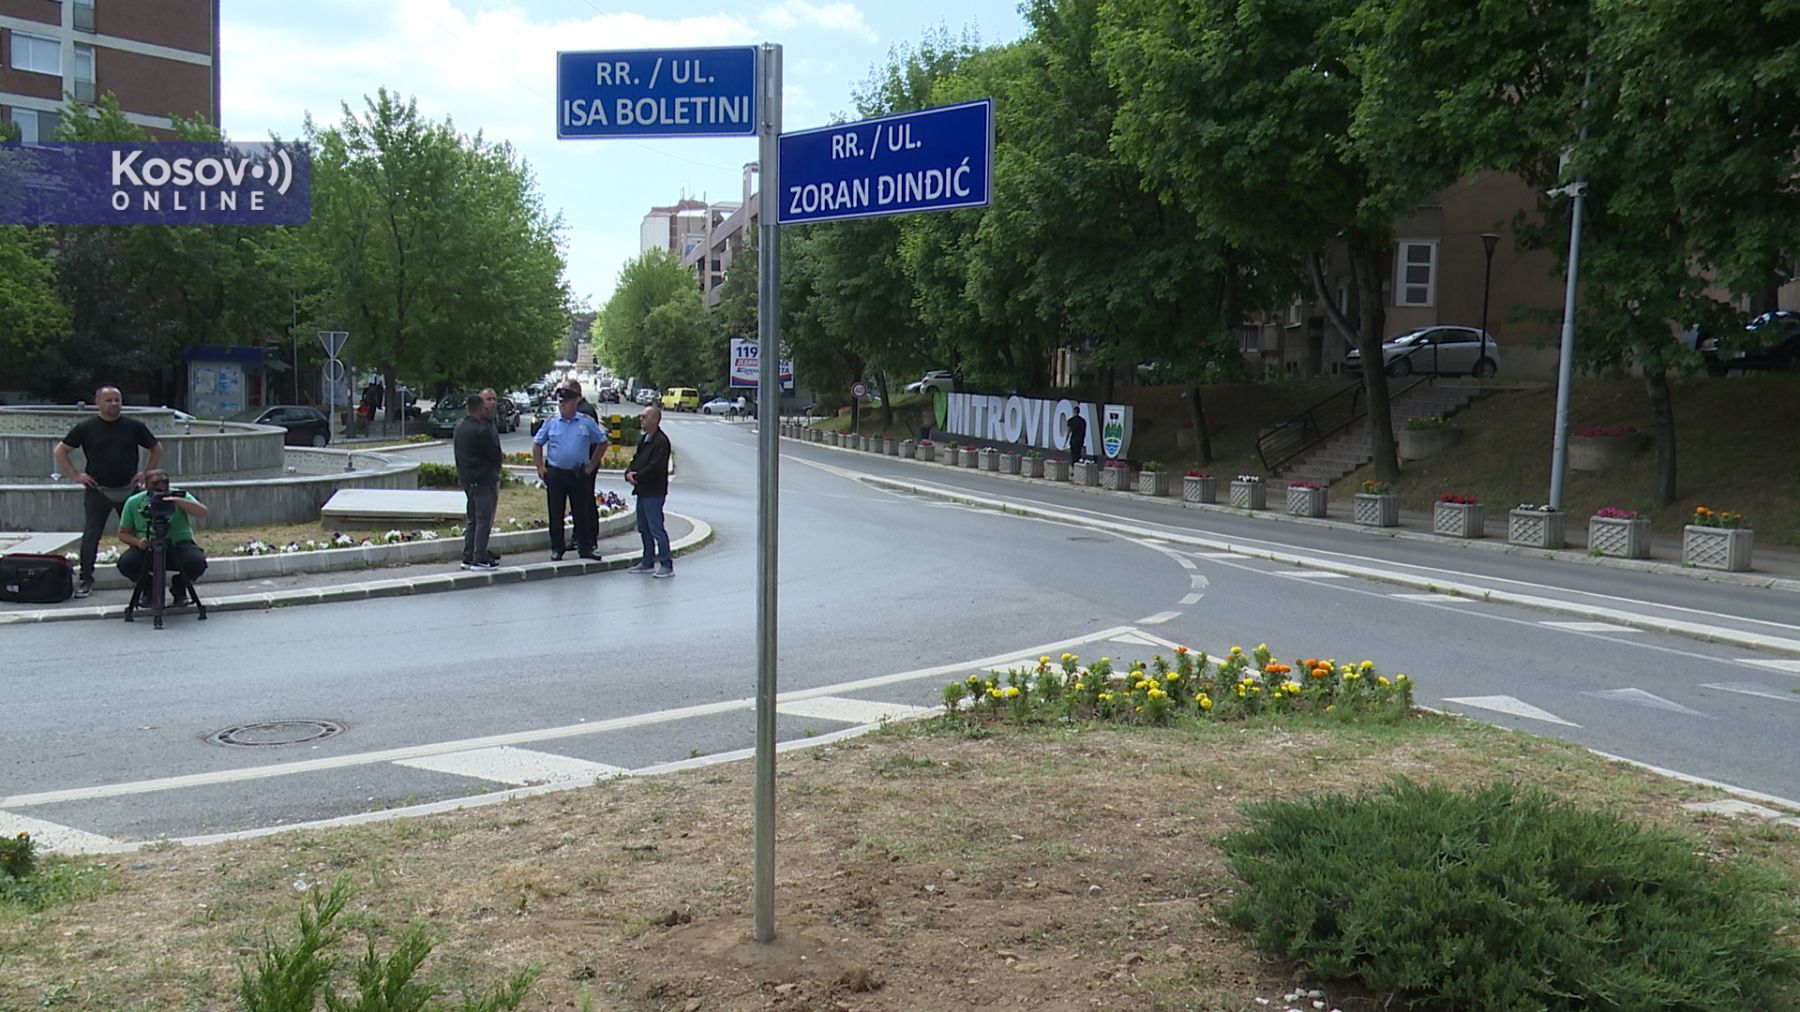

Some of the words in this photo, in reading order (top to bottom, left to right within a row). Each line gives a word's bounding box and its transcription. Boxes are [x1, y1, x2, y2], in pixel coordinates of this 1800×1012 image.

[596, 60, 640, 86] RR.
[648, 57, 663, 89] /
[672, 58, 715, 85] UL.
[563, 98, 608, 126] ISA
[615, 95, 750, 126] BOLETINI
[831, 132, 865, 161] RR.
[869, 124, 882, 160] /
[888, 123, 922, 151] UL.
[789, 178, 870, 215] ZORAN
[736, 346, 758, 358] 119
